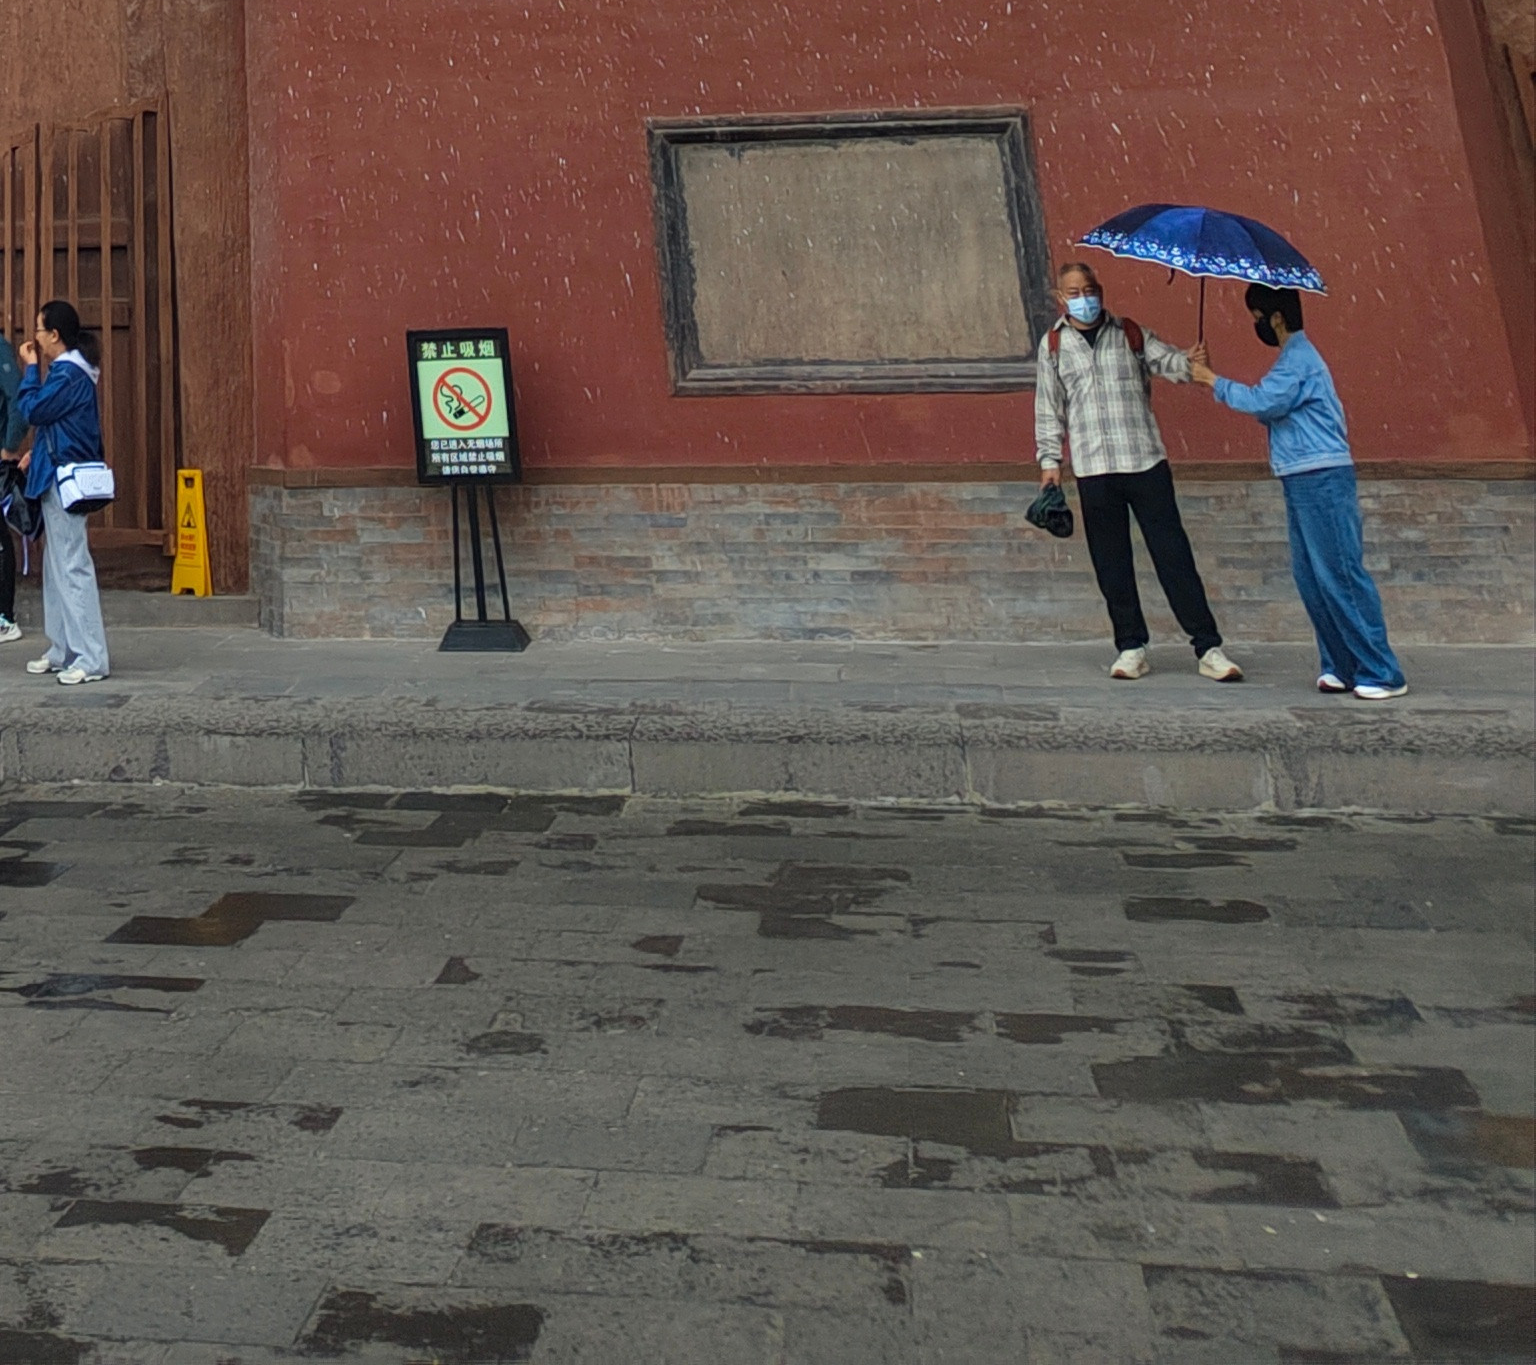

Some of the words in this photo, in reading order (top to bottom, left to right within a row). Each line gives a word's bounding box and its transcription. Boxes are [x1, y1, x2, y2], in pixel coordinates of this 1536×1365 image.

[421, 340, 495, 359] 禁止吸烟
[431, 451, 506, 464] 所有区域禁止吸烟
